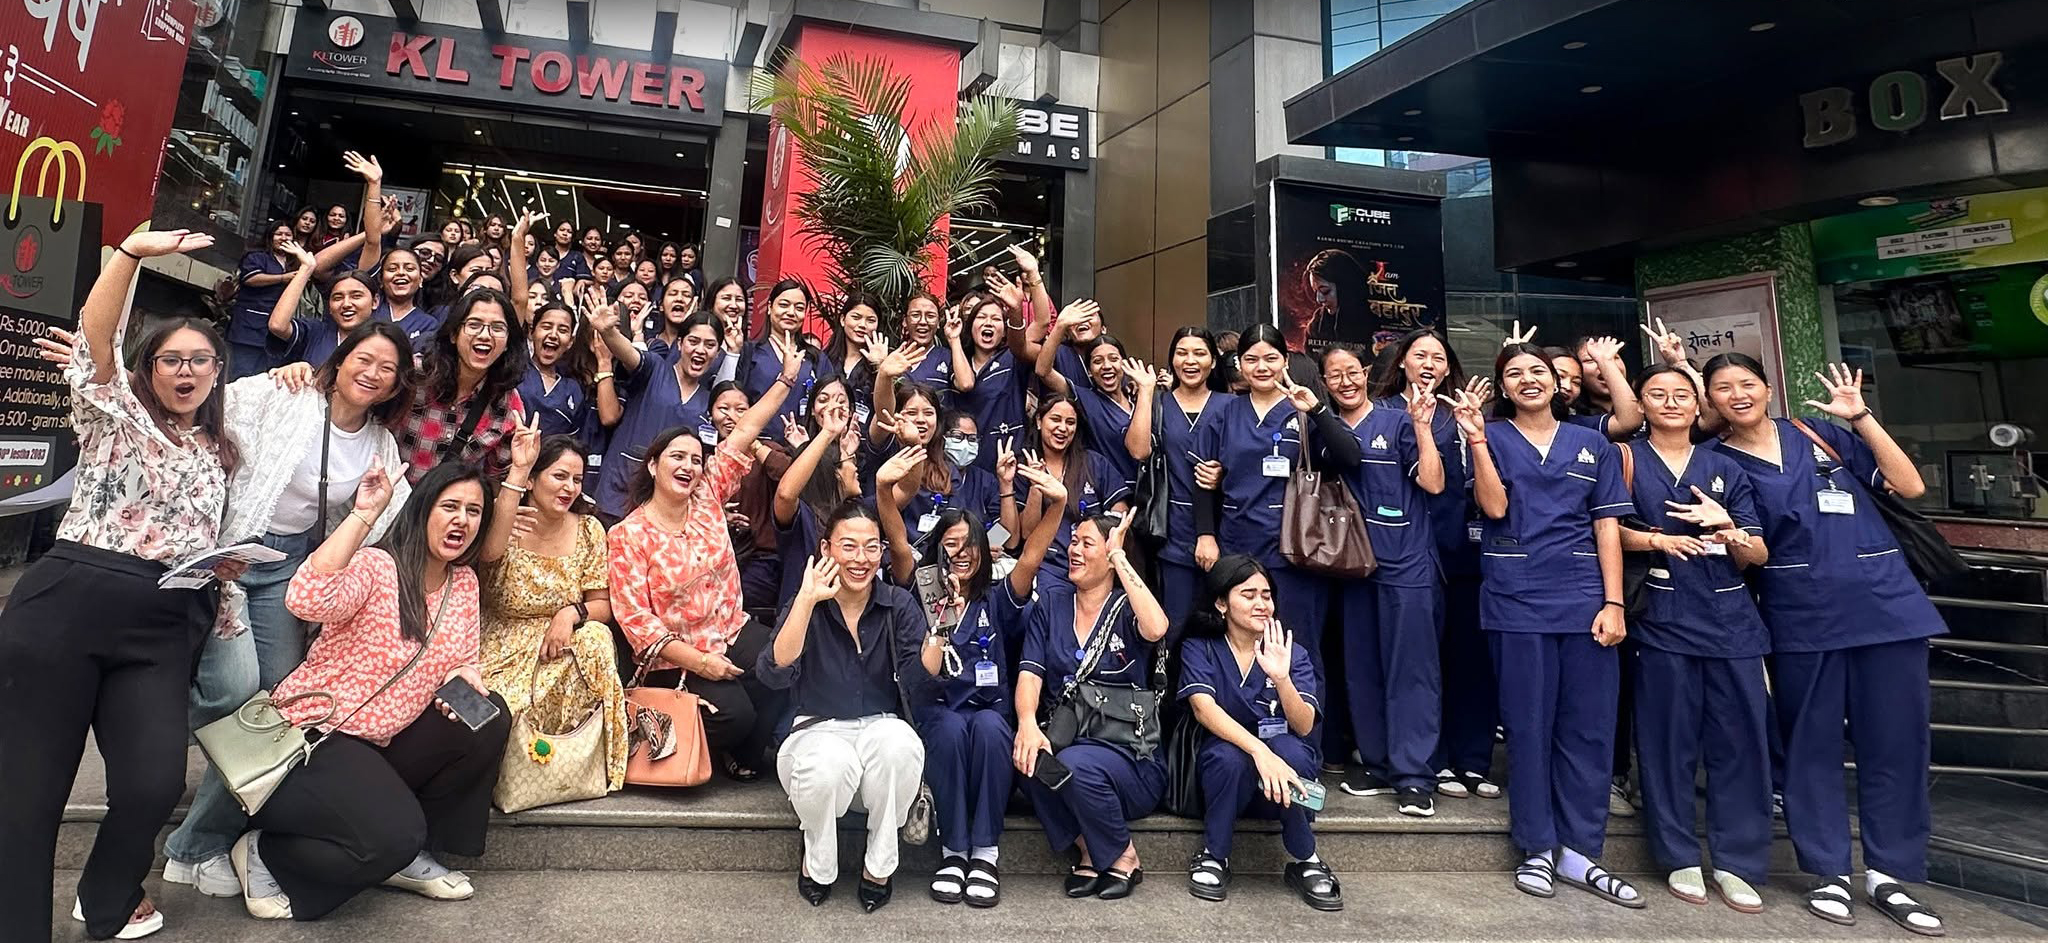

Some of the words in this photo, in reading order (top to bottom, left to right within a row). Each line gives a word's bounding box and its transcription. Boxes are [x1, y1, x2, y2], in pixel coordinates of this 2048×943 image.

[386, 31, 470, 83] KL
[491, 44, 706, 113] TOWER
[1800, 51, 2009, 148] BOX
[16, 318, 46, 336] 5,000
[0, 339, 16, 355] On
[14, 366, 46, 382] movie
[2, 387, 61, 410] Additionally,
[5, 410, 27, 427] 500
[31, 415, 58, 431] gram
